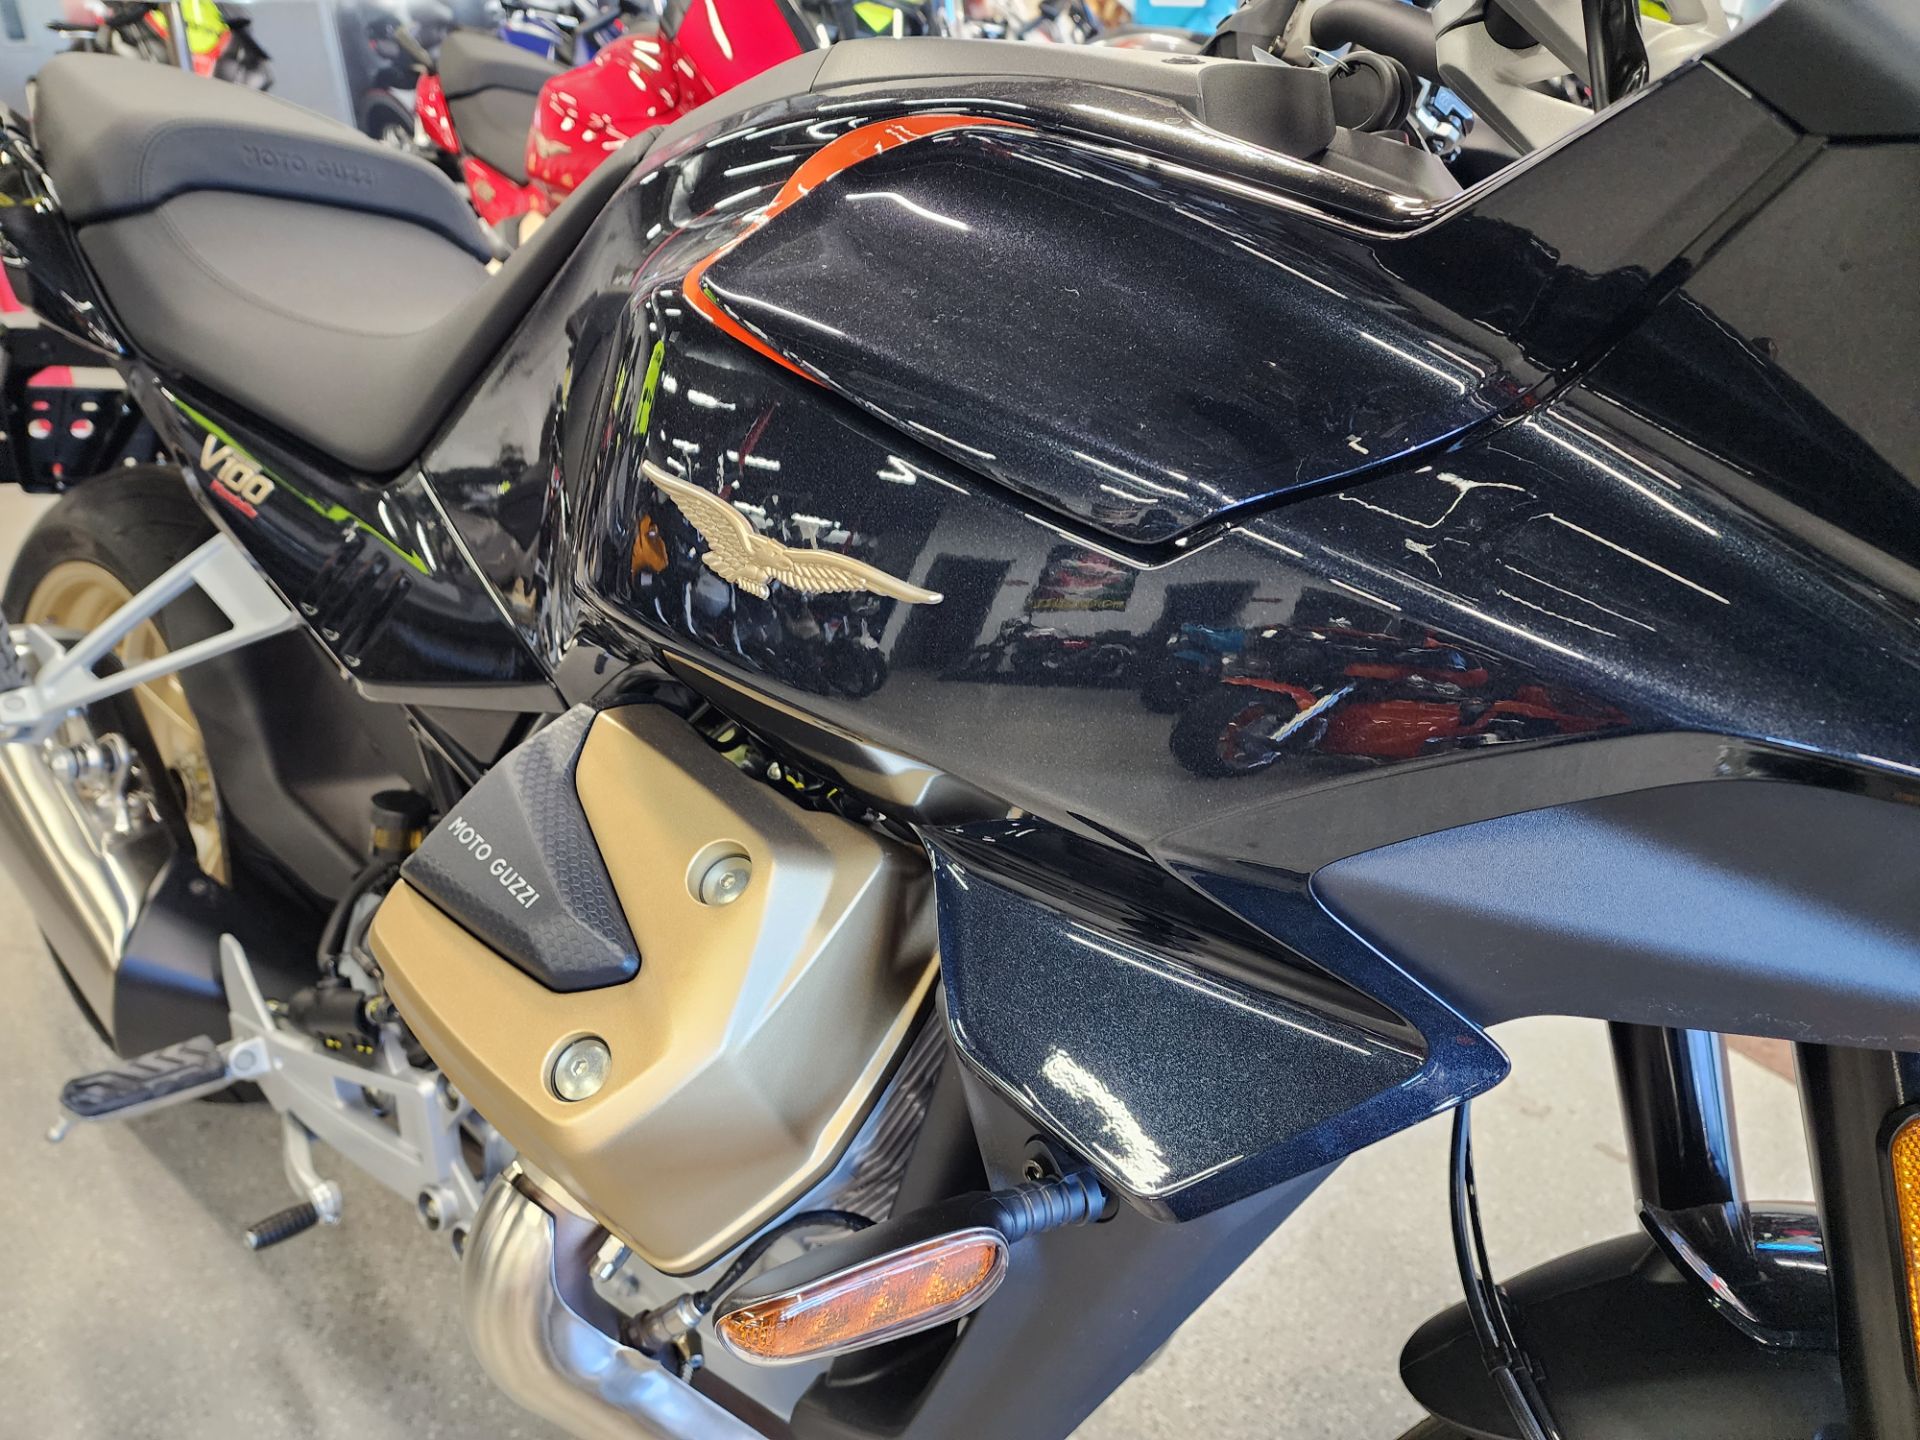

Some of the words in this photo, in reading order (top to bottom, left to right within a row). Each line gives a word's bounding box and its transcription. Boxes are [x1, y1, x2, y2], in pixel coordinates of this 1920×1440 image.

[242, 144, 308, 172] MOTO
[200, 433, 275, 505] V100
[447, 816, 492, 860] MOTO
[489, 858, 540, 909] GUZZI
